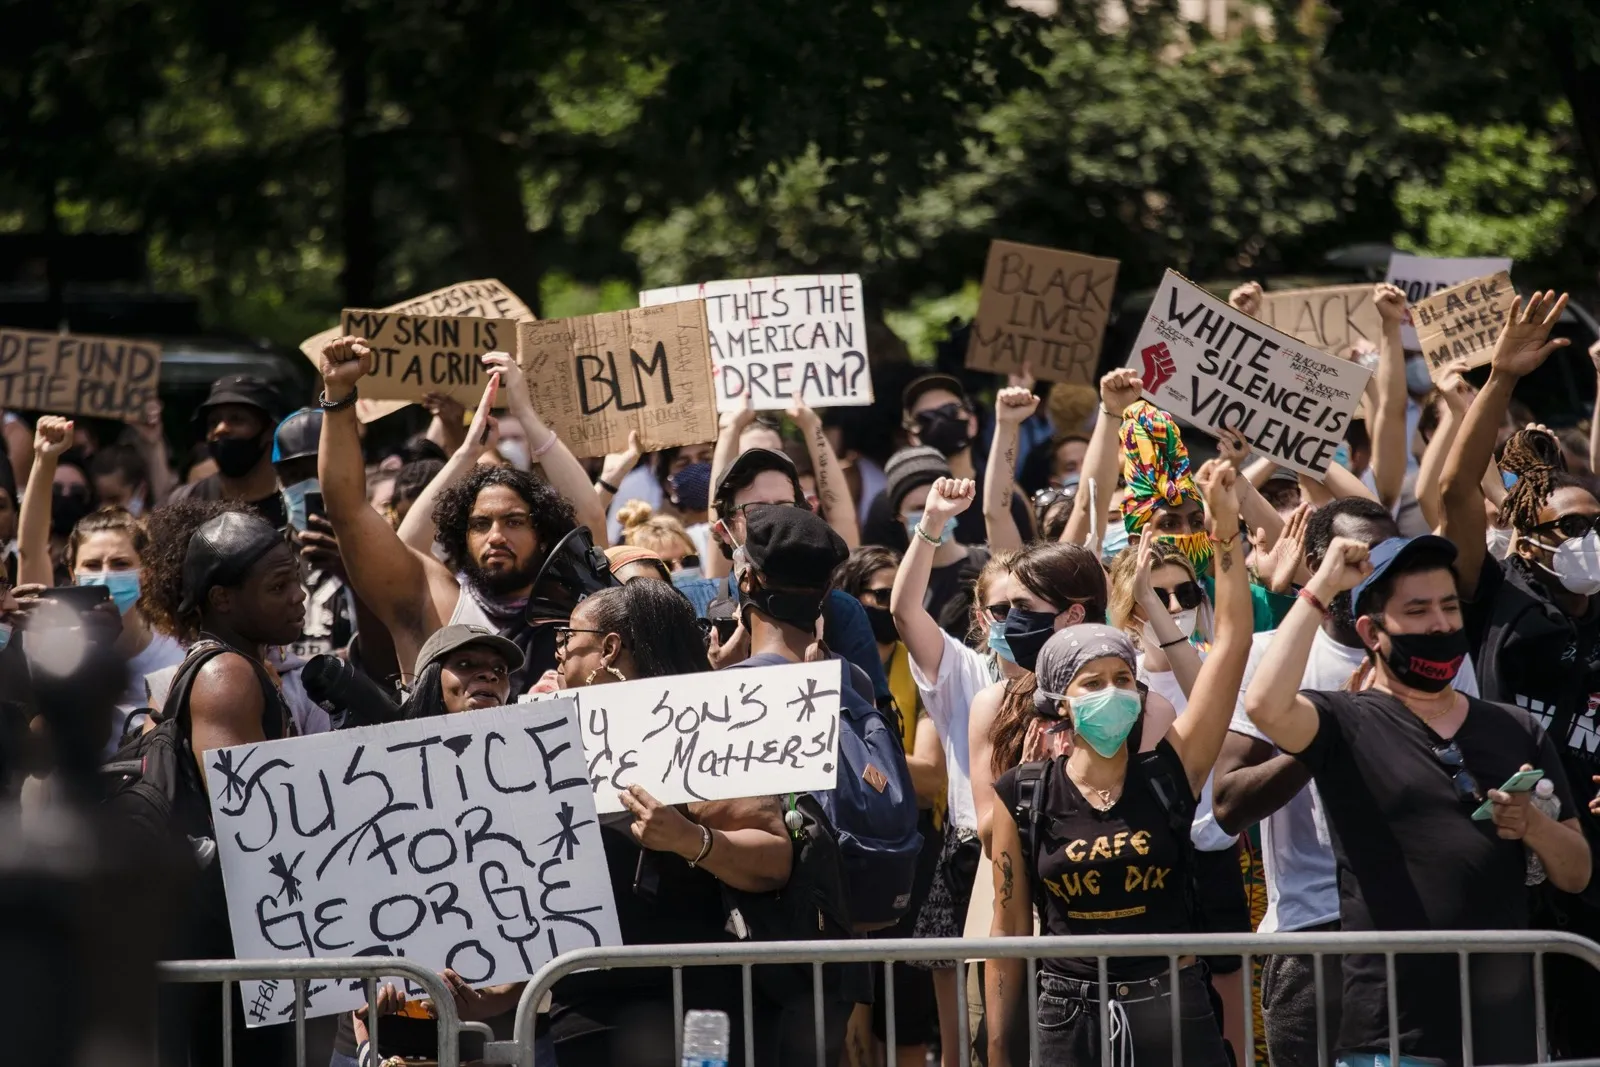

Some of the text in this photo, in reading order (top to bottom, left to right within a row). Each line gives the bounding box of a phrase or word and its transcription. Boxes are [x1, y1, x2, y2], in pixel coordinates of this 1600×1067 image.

[705, 285, 856, 323] THIS THE
[992, 252, 1113, 312] BLACK
[1419, 280, 1503, 326] BLACK
[346, 313, 498, 350] MY SKIN IS
[709, 321, 853, 360] AMERICAN
[1008, 296, 1098, 342] LIVES
[1168, 286, 1281, 375] WHITE
[1262, 291, 1368, 352] LACK
[1440, 302, 1504, 338] LIVES
[0, 334, 155, 383] DEFUND
[367, 347, 400, 377] OT
[401, 354, 423, 386] A
[970, 322, 1093, 384] MATTER
[1282, 347, 1339, 378] #BLACKLIVES
[1290, 361, 1321, 380] MATTER
[1428, 326, 1502, 369] MATTE
[0, 368, 76, 410] THE
[575, 340, 675, 416] BLM
[722, 350, 866, 400] DREAM?
[1197, 349, 1348, 434] SILENCE IS
[1295, 373, 1351, 401] #BLACKLIVES
[1303, 385, 1335, 402] MATTER
[1191, 375, 1339, 474] VIOLENCE
[1413, 659, 1448, 678] New
[641, 683, 768, 742] SON'S
[220, 717, 589, 853] JUSTICE
[316, 801, 536, 880] FOR
[1065, 830, 1152, 862] CAFE
[1124, 865, 1172, 893] DIX
[256, 857, 603, 958] GEORGE
